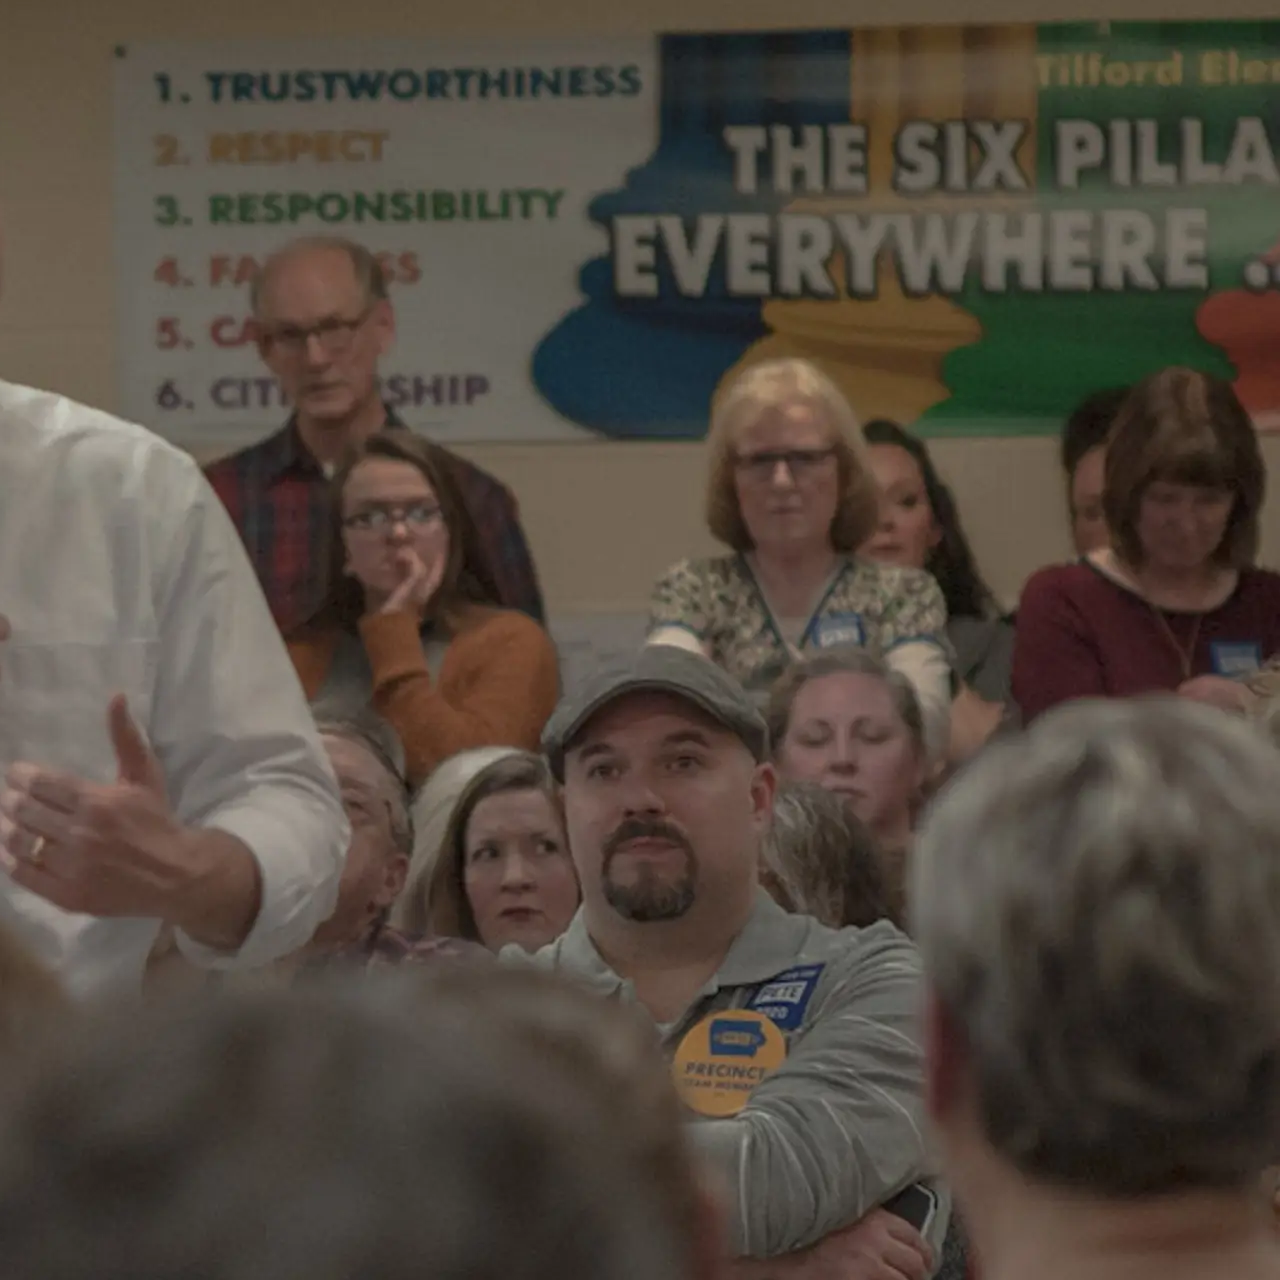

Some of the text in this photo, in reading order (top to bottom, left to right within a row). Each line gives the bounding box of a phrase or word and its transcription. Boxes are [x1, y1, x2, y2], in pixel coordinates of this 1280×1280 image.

[154, 65, 642, 104] 1. TRUSTWORTHINESS
[1035, 49, 1280, 87] Tilford Ele
[154, 129, 390, 167] 2. RESPECT
[725, 116, 1280, 195] THE SIX PILLA
[154, 188, 566, 226] 3. RESPONSIBILITY
[154, 253, 421, 287] 4. FASS
[613, 211, 1209, 296] EVERYWHERE
[155, 317, 193, 350] 5.
[155, 376, 490, 412] 6. CITISHIP
